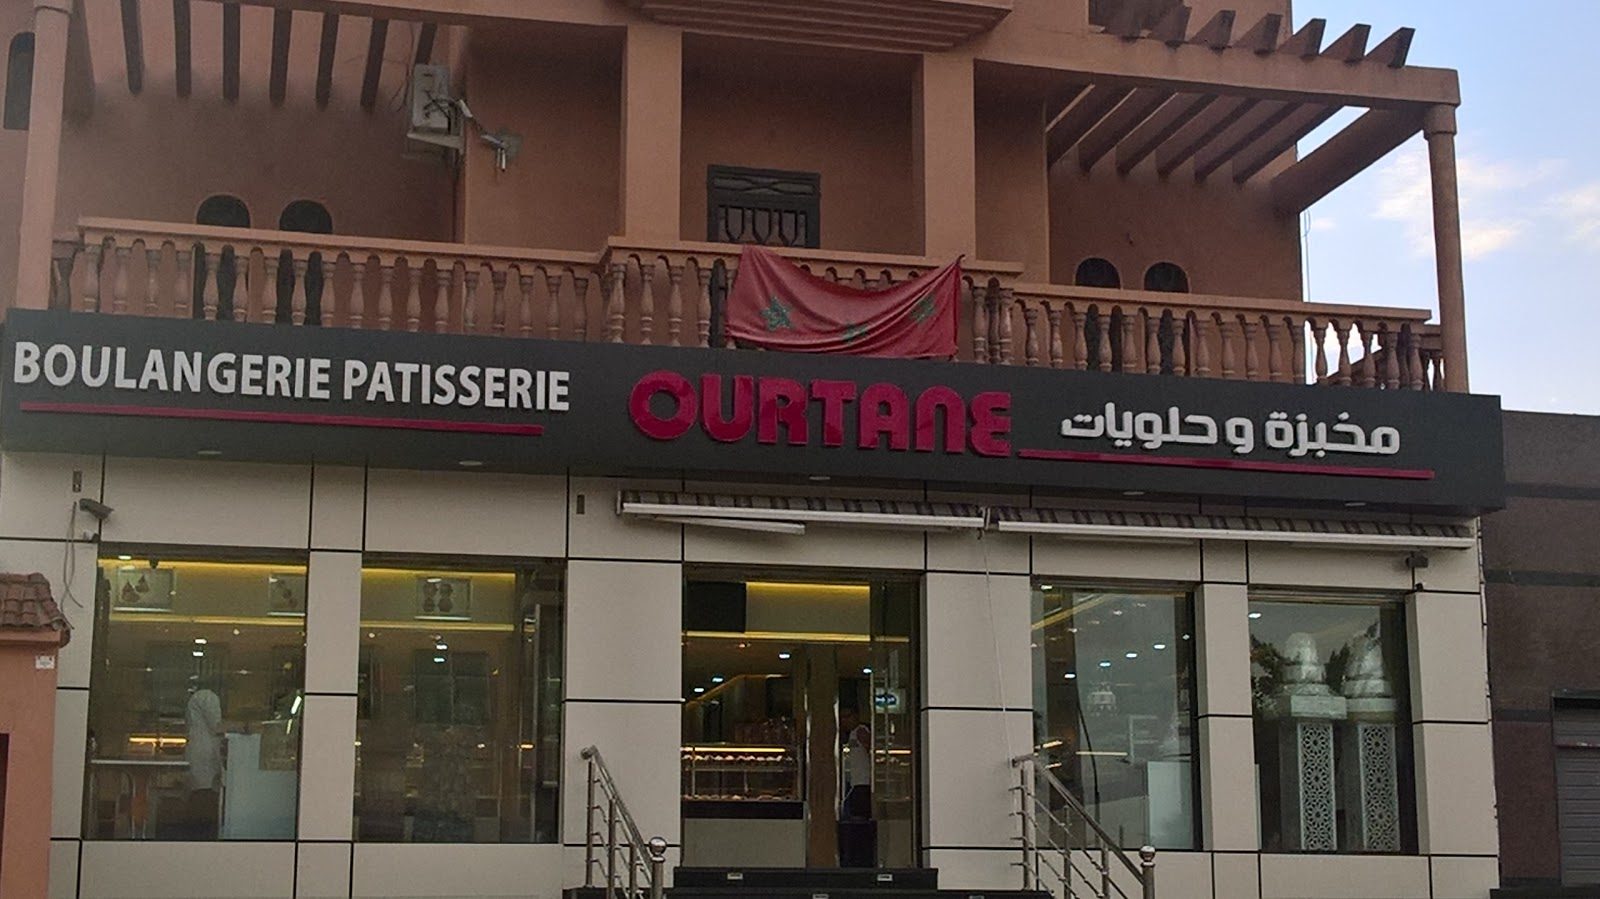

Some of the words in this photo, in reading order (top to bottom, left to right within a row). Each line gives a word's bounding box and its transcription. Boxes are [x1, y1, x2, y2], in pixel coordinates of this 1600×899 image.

[14, 341, 332, 399] BOULANGERIE
[343, 359, 570, 411] PATISSERIE
[628, 370, 1012, 457] OURTANE
[1265, 411, 1401, 457] مخبزة
